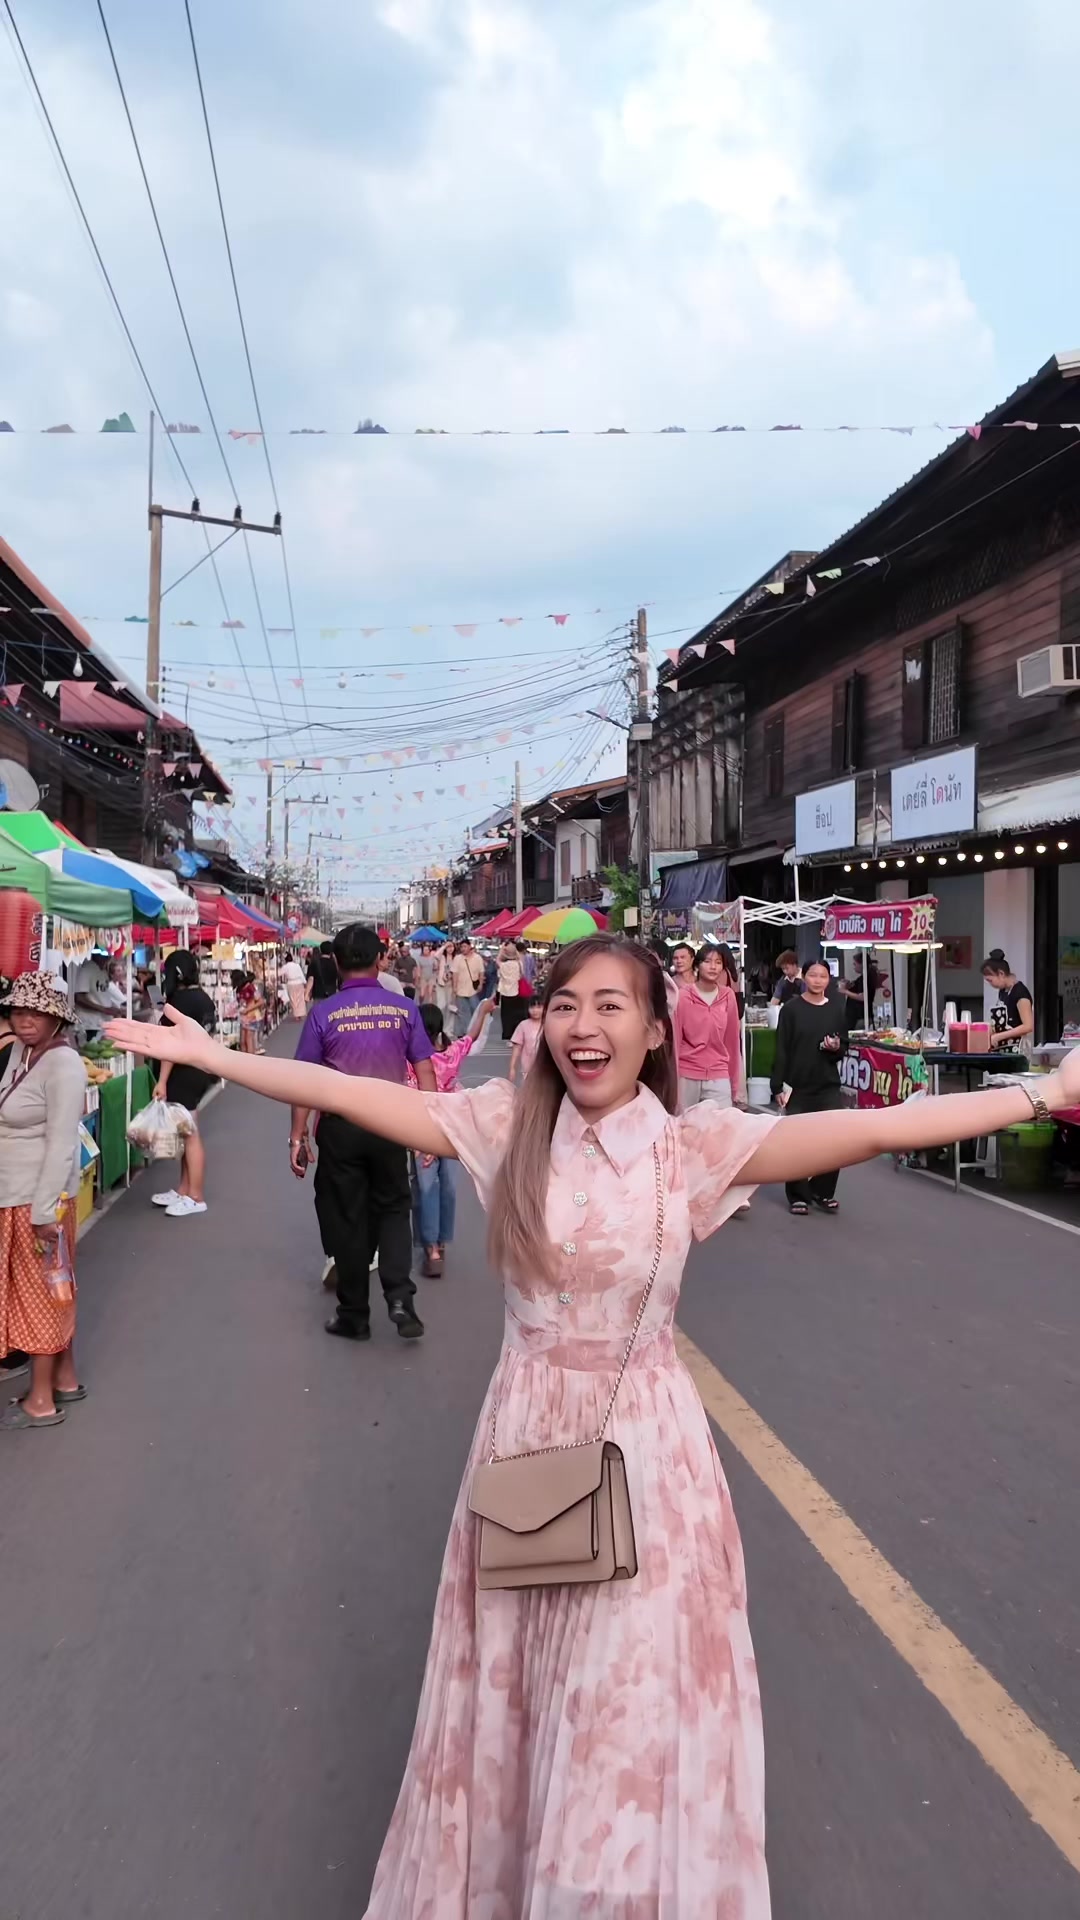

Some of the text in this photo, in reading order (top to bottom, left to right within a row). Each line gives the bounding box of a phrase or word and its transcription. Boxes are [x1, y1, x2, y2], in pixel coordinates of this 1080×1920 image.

[902, 772, 962, 811] เดย์ลี่ โดนัท
[839, 914, 867, 933] บาบีคิว
[871, 917, 885, 937] หมู
[889, 910, 902, 932] ไก่
[913, 914, 927, 930] 10
[873, 1070, 892, 1105] หมู
[895, 1063, 913, 1100] ไก่
